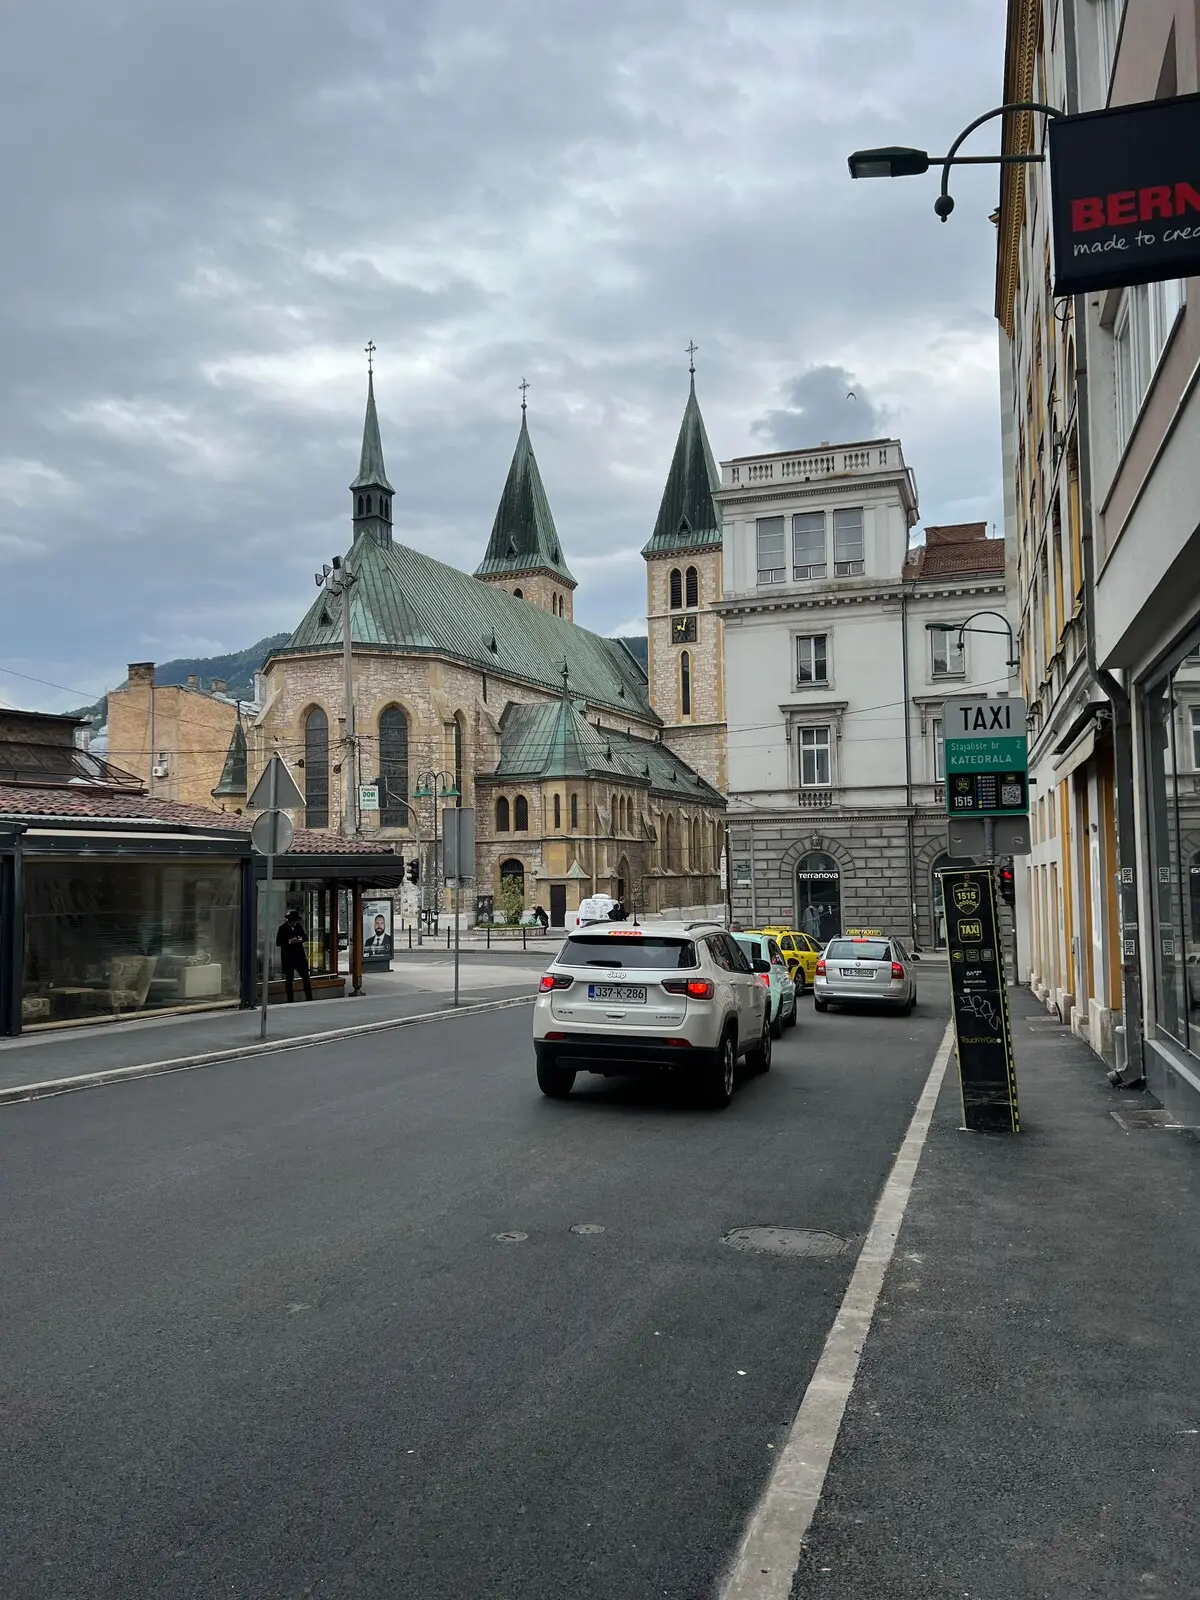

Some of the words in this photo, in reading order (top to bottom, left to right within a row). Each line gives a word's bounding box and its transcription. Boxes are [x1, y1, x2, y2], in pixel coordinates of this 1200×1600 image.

[1070, 181, 1200, 232] BERN
[1073, 234, 1129, 257] made
[1135, 230, 1155, 247] to
[959, 706, 1011, 731] TAXI
[1016, 740, 1021, 749] 2
[950, 754, 1012, 765] KATEDRALA
[953, 796, 973, 807] 1515
[1123, 868, 1132, 883] BNE
[957, 892, 976, 900] 1515
[1126, 940, 1135, 955] BNE
[607, 971, 626, 979] Jeep
[595, 987, 644, 999] J37-K-286
